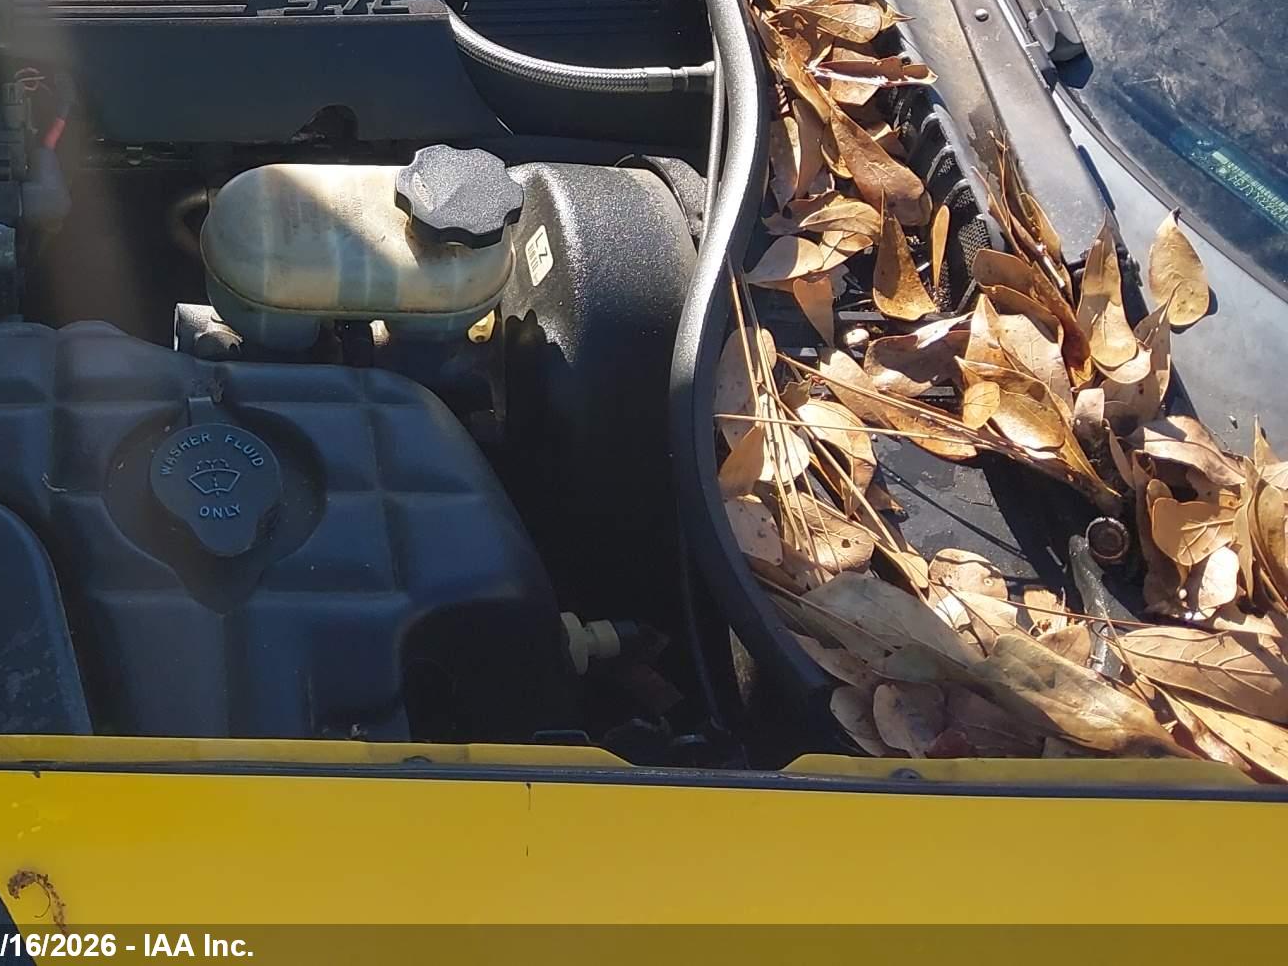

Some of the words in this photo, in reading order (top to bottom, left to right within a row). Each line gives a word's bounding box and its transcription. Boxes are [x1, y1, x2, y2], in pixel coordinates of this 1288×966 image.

[160, 433, 212, 475] WASHER
[225, 434, 264, 466] FLUID
[199, 504, 241, 518] ONLY
